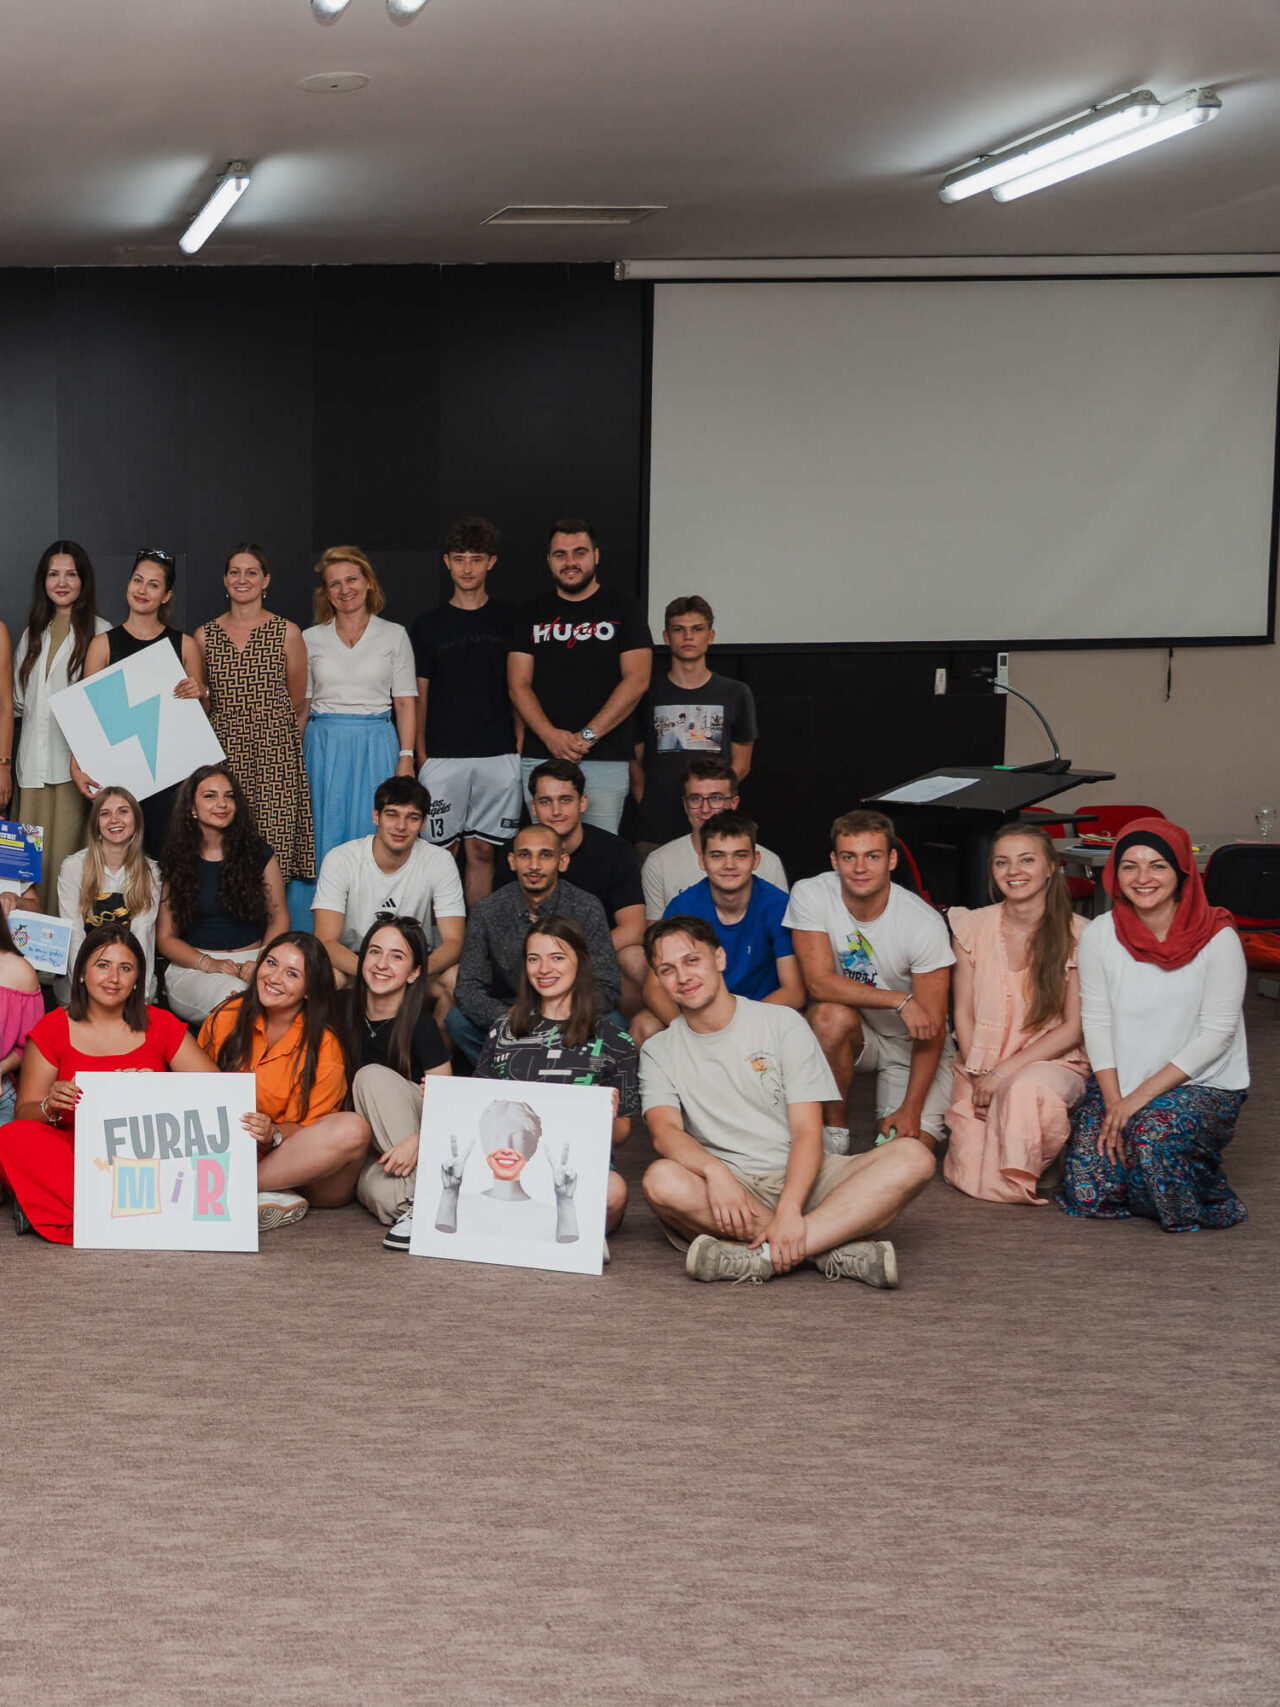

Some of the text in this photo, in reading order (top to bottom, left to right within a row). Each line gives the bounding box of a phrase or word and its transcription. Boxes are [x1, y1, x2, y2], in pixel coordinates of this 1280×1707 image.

[532, 621, 615, 644] HUGO
[430, 818, 444, 838] 13
[103, 1106, 230, 1165] FURAJ
